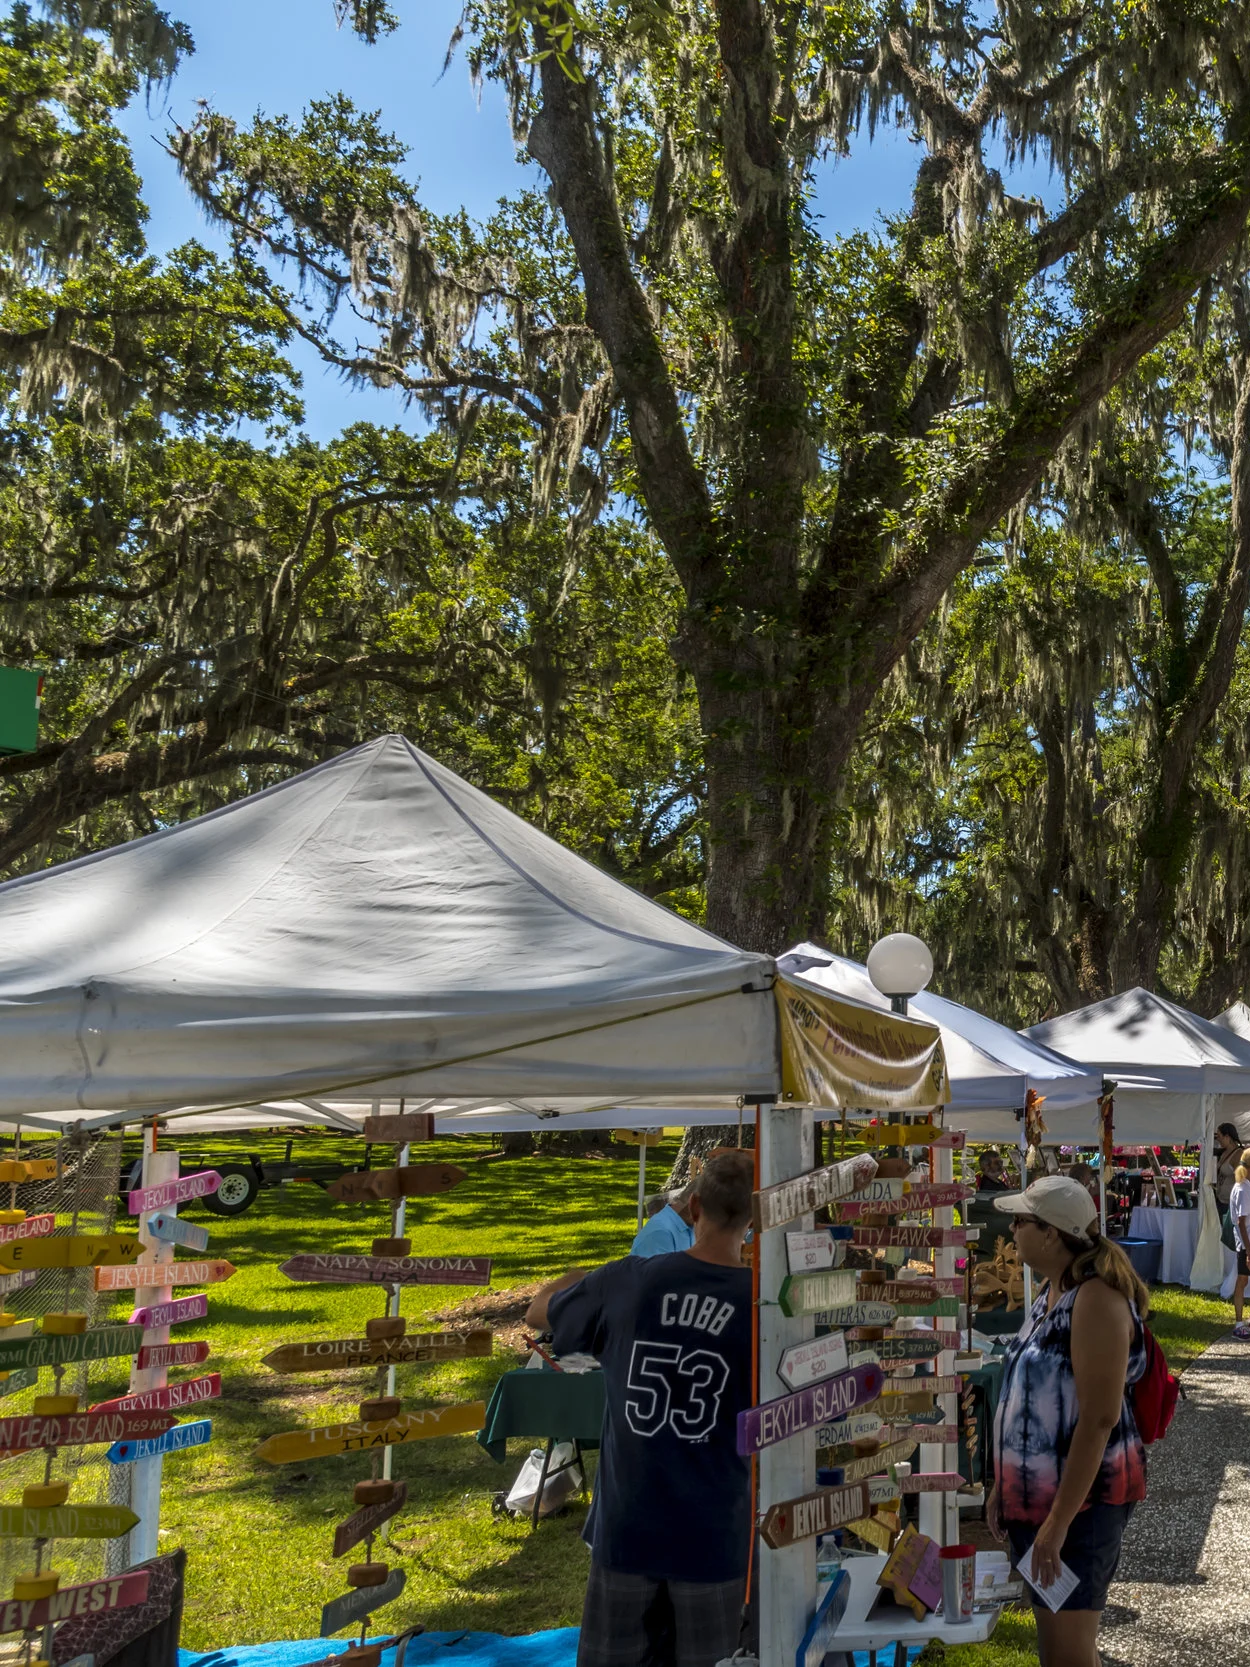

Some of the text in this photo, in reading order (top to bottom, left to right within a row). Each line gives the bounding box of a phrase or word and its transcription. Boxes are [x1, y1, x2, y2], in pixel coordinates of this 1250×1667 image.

[866, 1133, 875, 1142] N
[928, 1131, 935, 1140] S
[143, 1180, 206, 1210] JEKYLL ISLAND
[768, 1167, 854, 1225] JEKYLL ISLAND
[842, 1182, 892, 1201] MUDA
[859, 1193, 931, 1216] GRANDMA
[0, 1218, 50, 1243] LEVELAND
[890, 1228, 932, 1247] HAWK
[13, 1246, 23, 1261] E
[119, 1244, 135, 1256] W
[110, 1264, 209, 1288] JEKYLL ISLAND
[314, 1256, 370, 1271] NAPA
[388, 1257, 477, 1272] SONOMA
[369, 1270, 419, 1283] USA
[871, 1283, 899, 1303] WALL
[150, 1303, 202, 1329] JEKYLL ISLAND
[660, 1293, 735, 1336] COBB
[26, 1336, 79, 1367] GRAND
[82, 1328, 138, 1360] CANYON
[150, 1345, 197, 1366] JEKYLL ISLAND
[303, 1332, 472, 1357] LOIRE VALLEY
[346, 1350, 427, 1368] FRANCE
[811, 1359, 827, 1376] $20
[118, 1379, 213, 1411] JEKYLL ISLAND
[625, 1340, 730, 1439] 53
[756, 1376, 857, 1447] JEKYLL ISLAND
[18, 1417, 61, 1448] HEAD
[66, 1414, 124, 1444] ISLAND
[307, 1408, 447, 1443] TUSCANY
[134, 1425, 204, 1460] JEKYLL ISLAND
[342, 1429, 410, 1451] ITALY
[23, 1510, 79, 1537] ISLAND
[793, 1496, 827, 1539] JEKYLL
[830, 1486, 863, 1525] ISLAND
[0, 1579, 123, 1632] EY WEST
